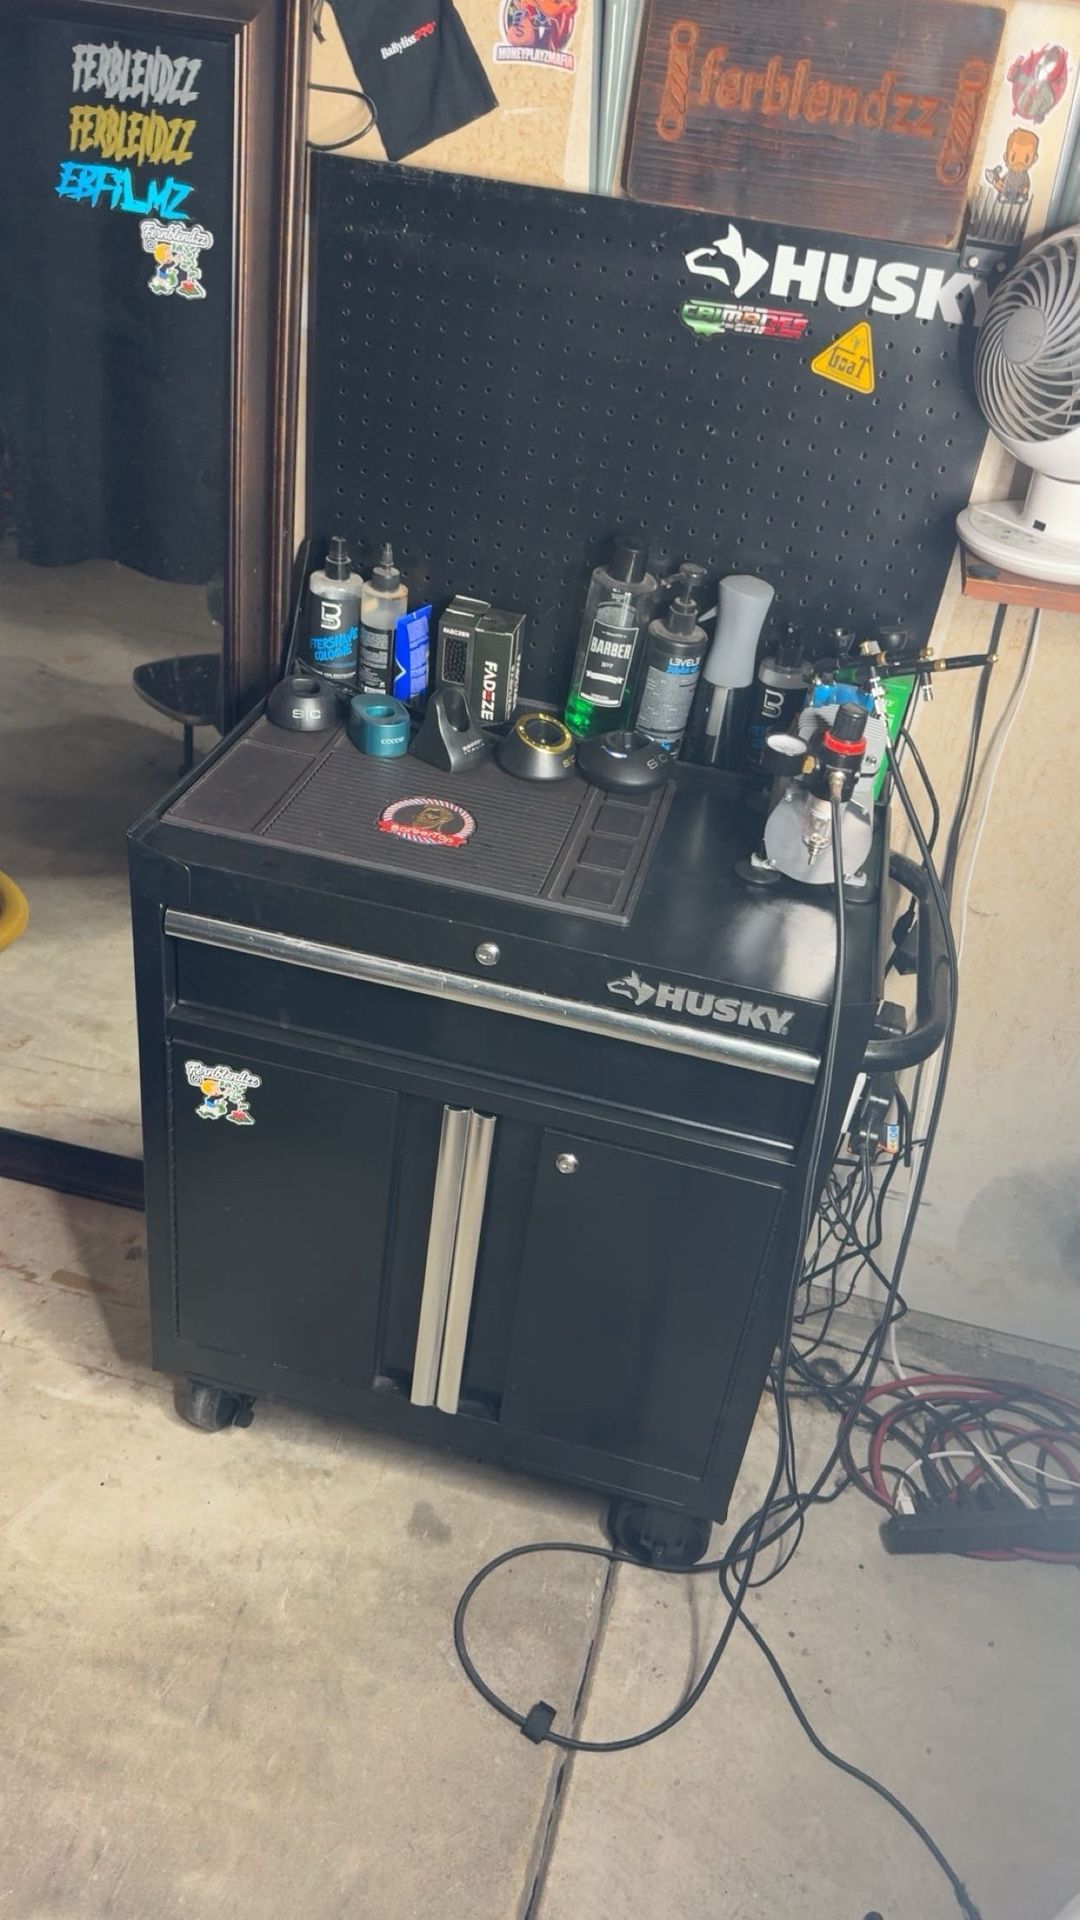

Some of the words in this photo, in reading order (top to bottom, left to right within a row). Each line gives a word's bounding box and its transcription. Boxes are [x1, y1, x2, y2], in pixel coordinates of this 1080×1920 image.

[71, 41, 202, 107] FERBLENDZZ
[699, 46, 940, 138] ferblendzz
[68, 104, 197, 167] FERBLENDZZ
[590, 636, 632, 660] BARBER
[480, 660, 498, 721] FADEZE
[655, 981, 796, 1036] HUSKY
